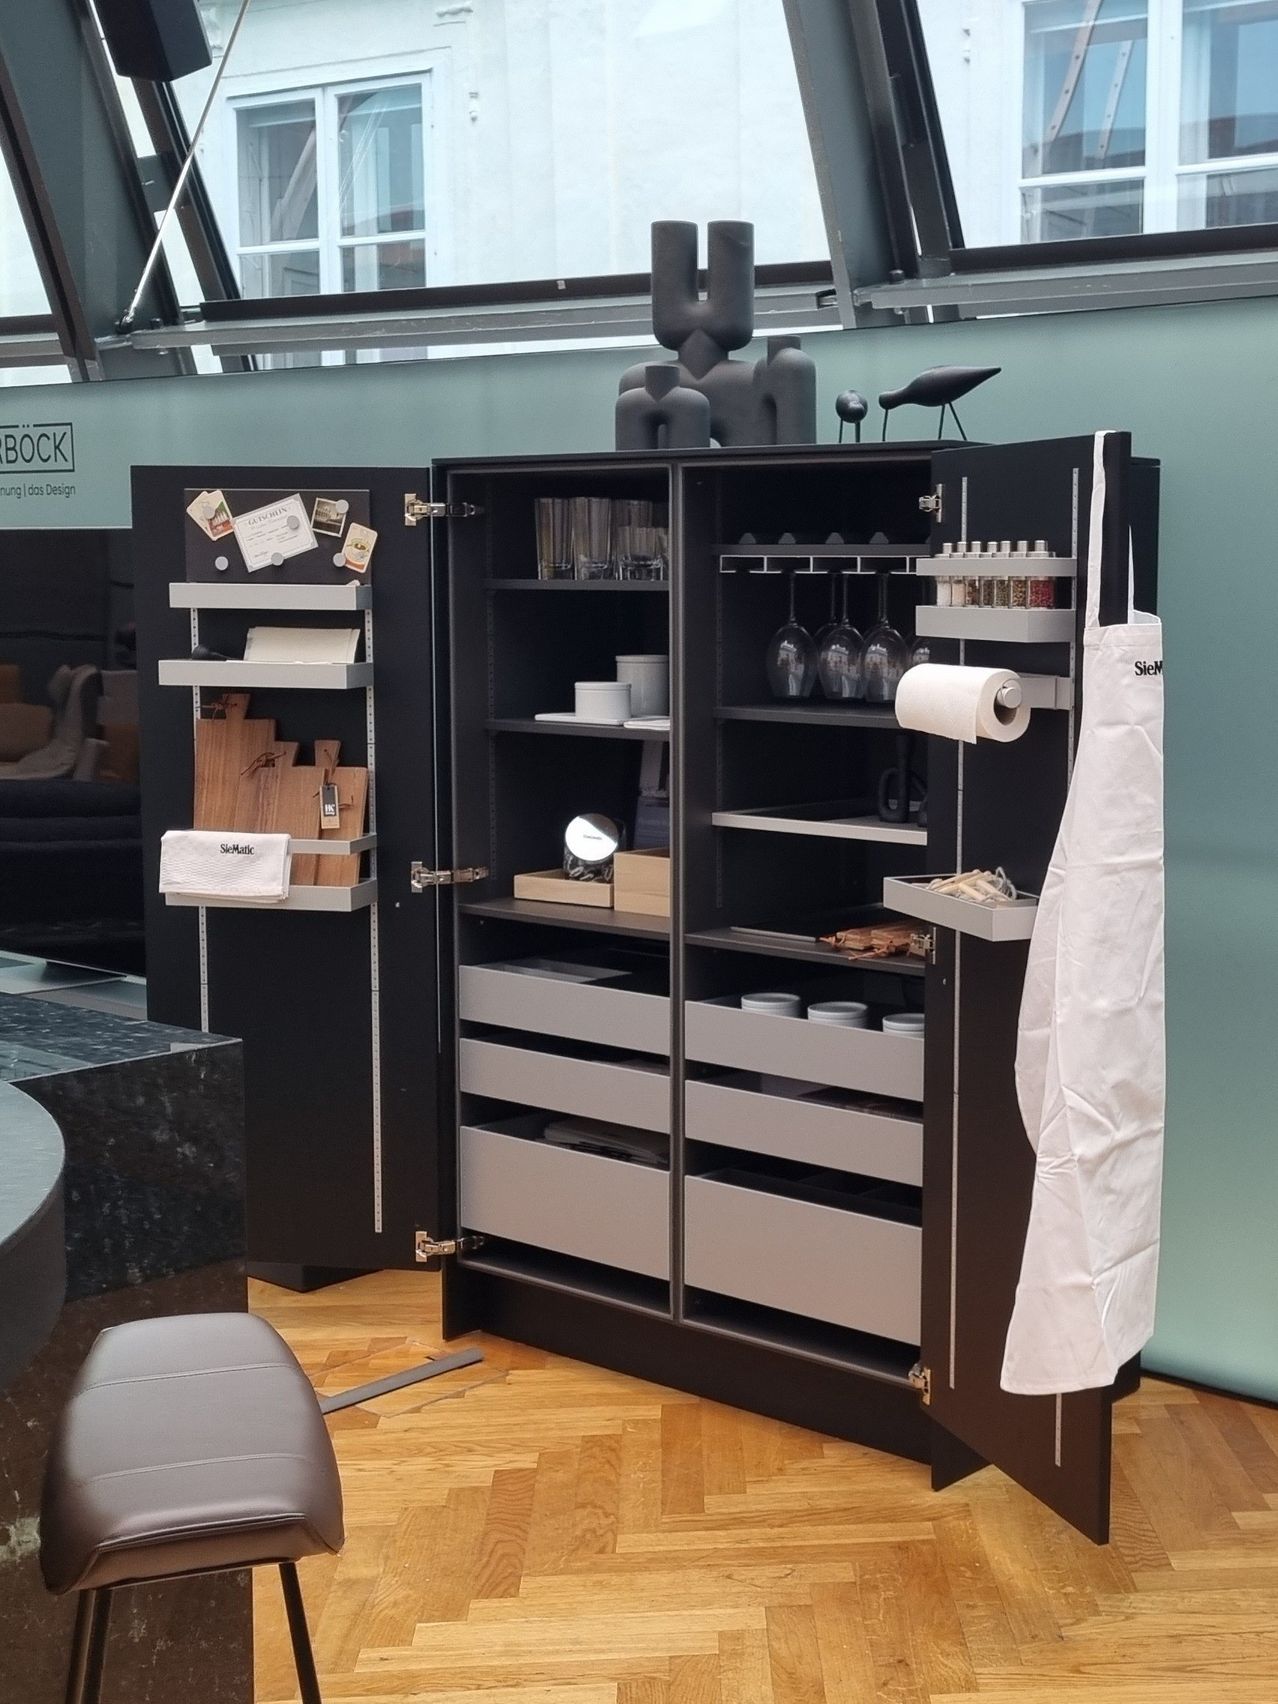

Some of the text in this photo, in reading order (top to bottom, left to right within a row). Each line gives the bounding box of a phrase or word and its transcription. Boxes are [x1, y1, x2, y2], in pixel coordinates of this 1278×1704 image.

[0, 424, 68, 464] BÖCK
[28, 484, 44, 496] das
[46, 483, 76, 498] Design
[220, 843, 255, 855] SieMatic
